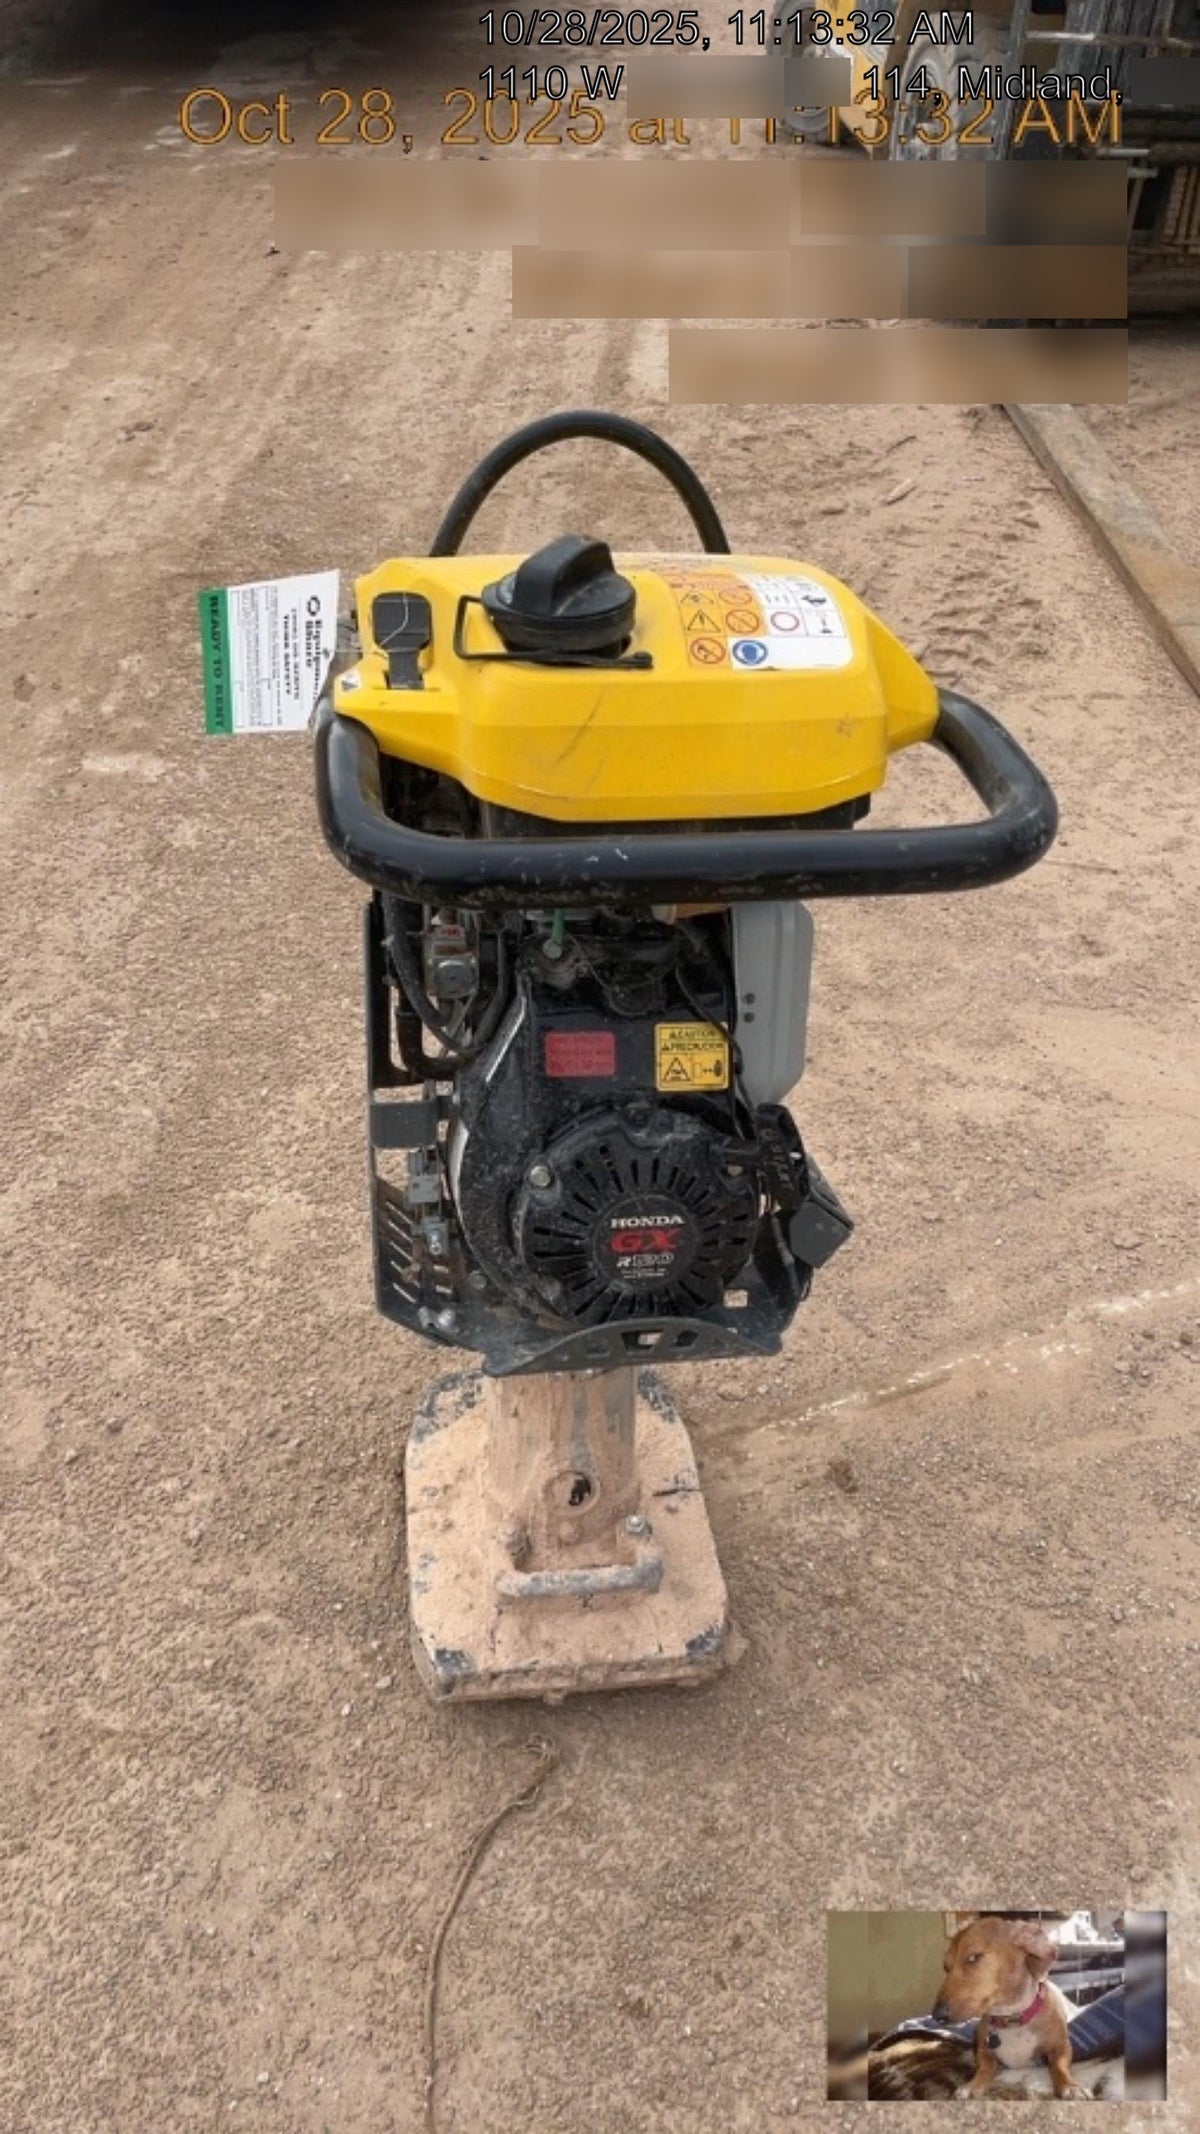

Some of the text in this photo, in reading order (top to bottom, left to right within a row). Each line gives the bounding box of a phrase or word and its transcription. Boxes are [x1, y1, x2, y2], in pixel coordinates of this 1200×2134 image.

[209, 595, 225, 728] READY TO RENT
[610, 1214, 686, 1230] HONDA
[611, 1227, 683, 1252] GX
